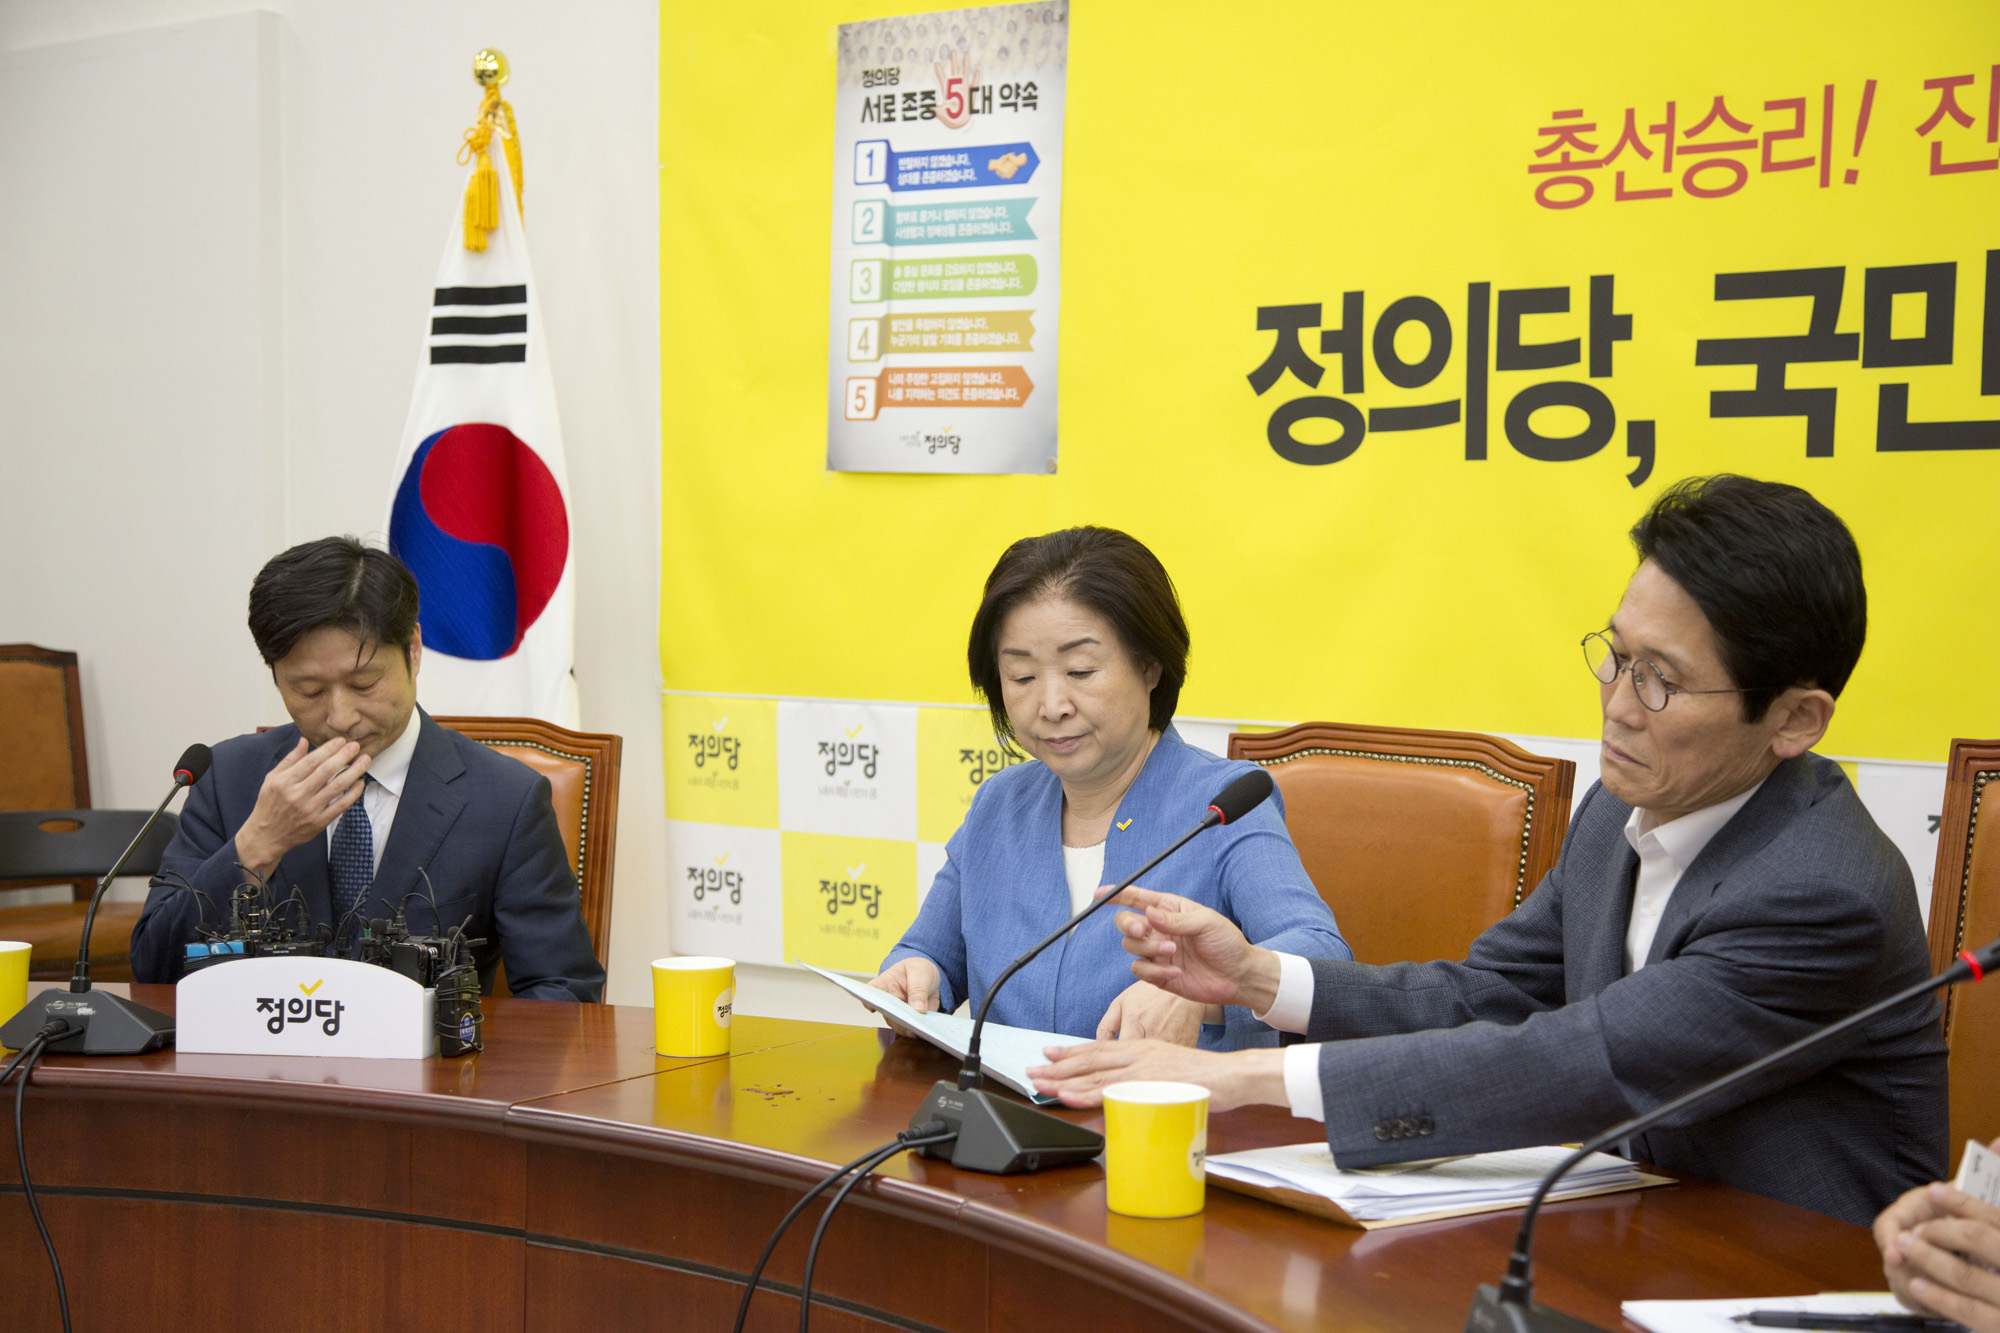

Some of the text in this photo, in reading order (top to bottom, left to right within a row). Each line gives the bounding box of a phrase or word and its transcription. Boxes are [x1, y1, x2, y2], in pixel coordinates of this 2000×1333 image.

[861, 66, 900, 88] 정의당
[861, 94, 896, 123] 서로
[901, 90, 937, 122] 존중
[999, 81, 1038, 113] 약속
[1526, 64, 2000, 211] 총선승리! 진
[865, 149, 875, 177] 1
[861, 208, 875, 235] 2
[859, 267, 873, 295] 3
[857, 326, 870, 355] 4
[1245, 249, 2000, 490] 정의당, 국민
[854, 386, 867, 412] 5
[924, 435, 962, 455] 정의당
[688, 734, 741, 771] 정의당
[818, 741, 879, 779] 정의당
[959, 749, 1025, 785] 정의
[687, 866, 743, 905] 정의당
[818, 879, 882, 919] 정의당
[256, 996, 345, 1037] 정의당
